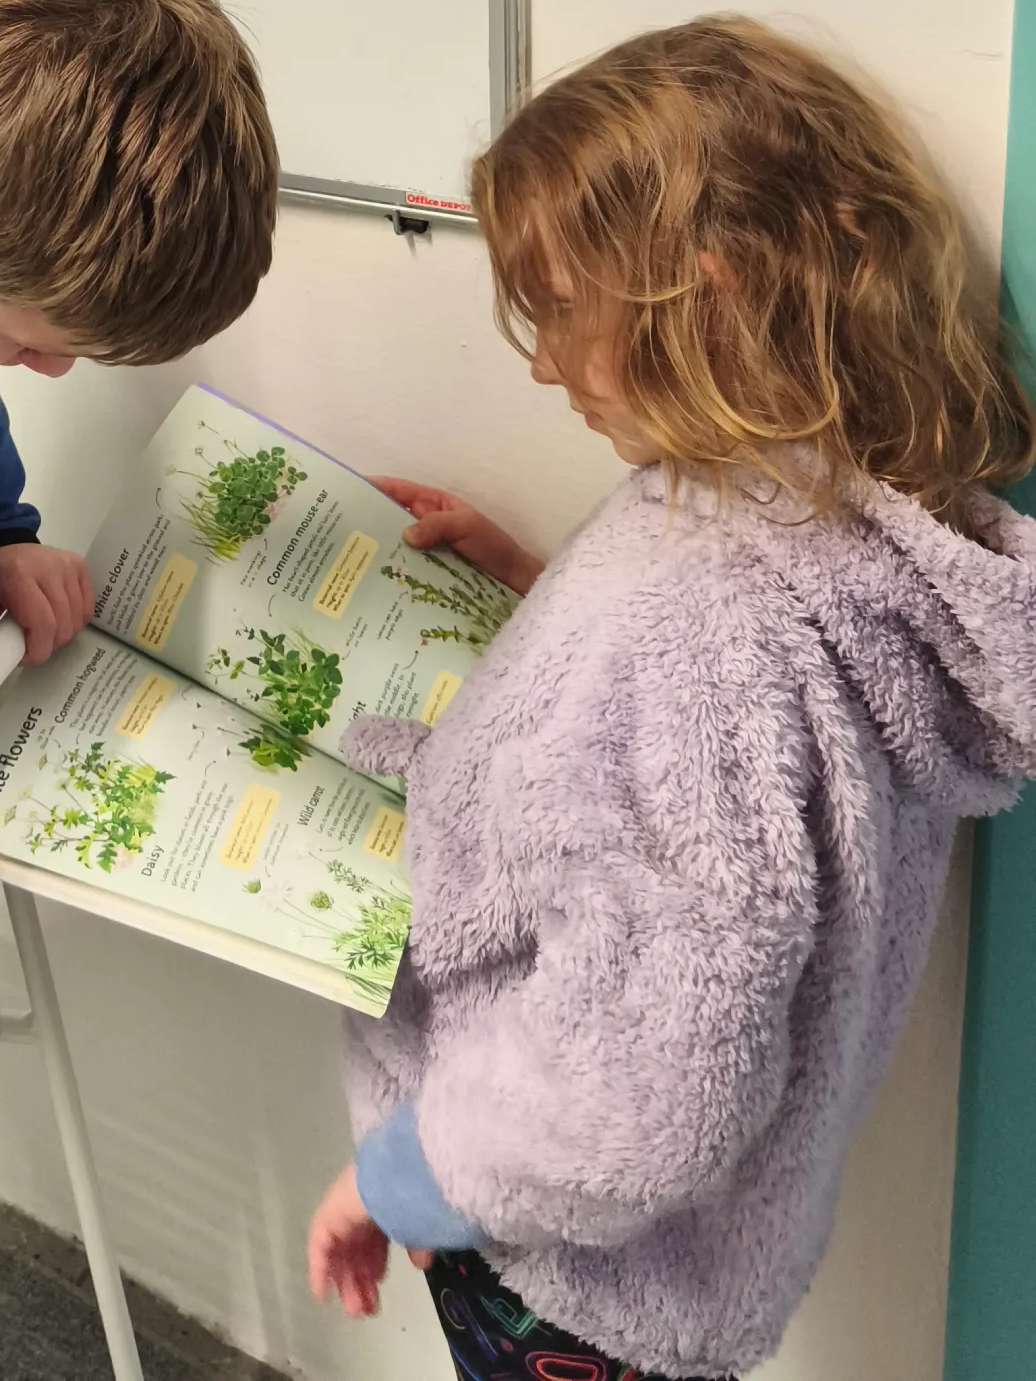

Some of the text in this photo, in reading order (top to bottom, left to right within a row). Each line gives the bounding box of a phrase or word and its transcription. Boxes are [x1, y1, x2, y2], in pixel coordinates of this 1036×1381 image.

[267, 490, 328, 585] Common mouse-ear
[93, 548, 129, 618] White clover
[55, 647, 106, 723] Common hogweed
[298, 786, 325, 825] Wild carrot
[141, 845, 164, 876] Daisy
